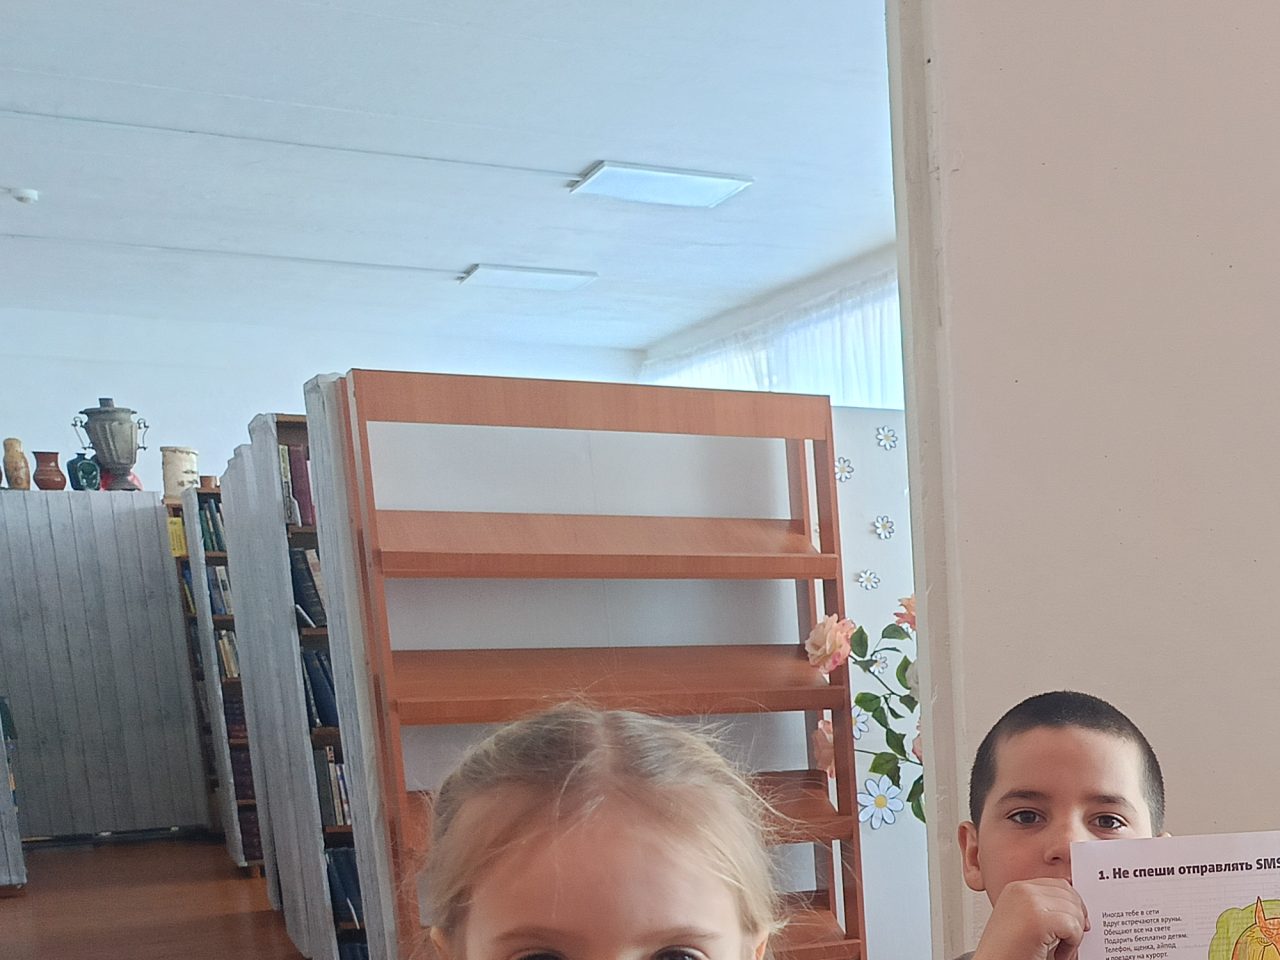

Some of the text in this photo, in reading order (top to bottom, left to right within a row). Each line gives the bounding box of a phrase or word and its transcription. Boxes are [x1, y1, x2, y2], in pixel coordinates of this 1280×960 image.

[1099, 870, 1109, 880] 1.
[1113, 868, 1129, 879] Не
[1133, 867, 1175, 878] спеши
[1178, 862, 1252, 876] отправлять
[1125, 909, 1139, 917] тебе
[1154, 923, 1171, 932] свете
